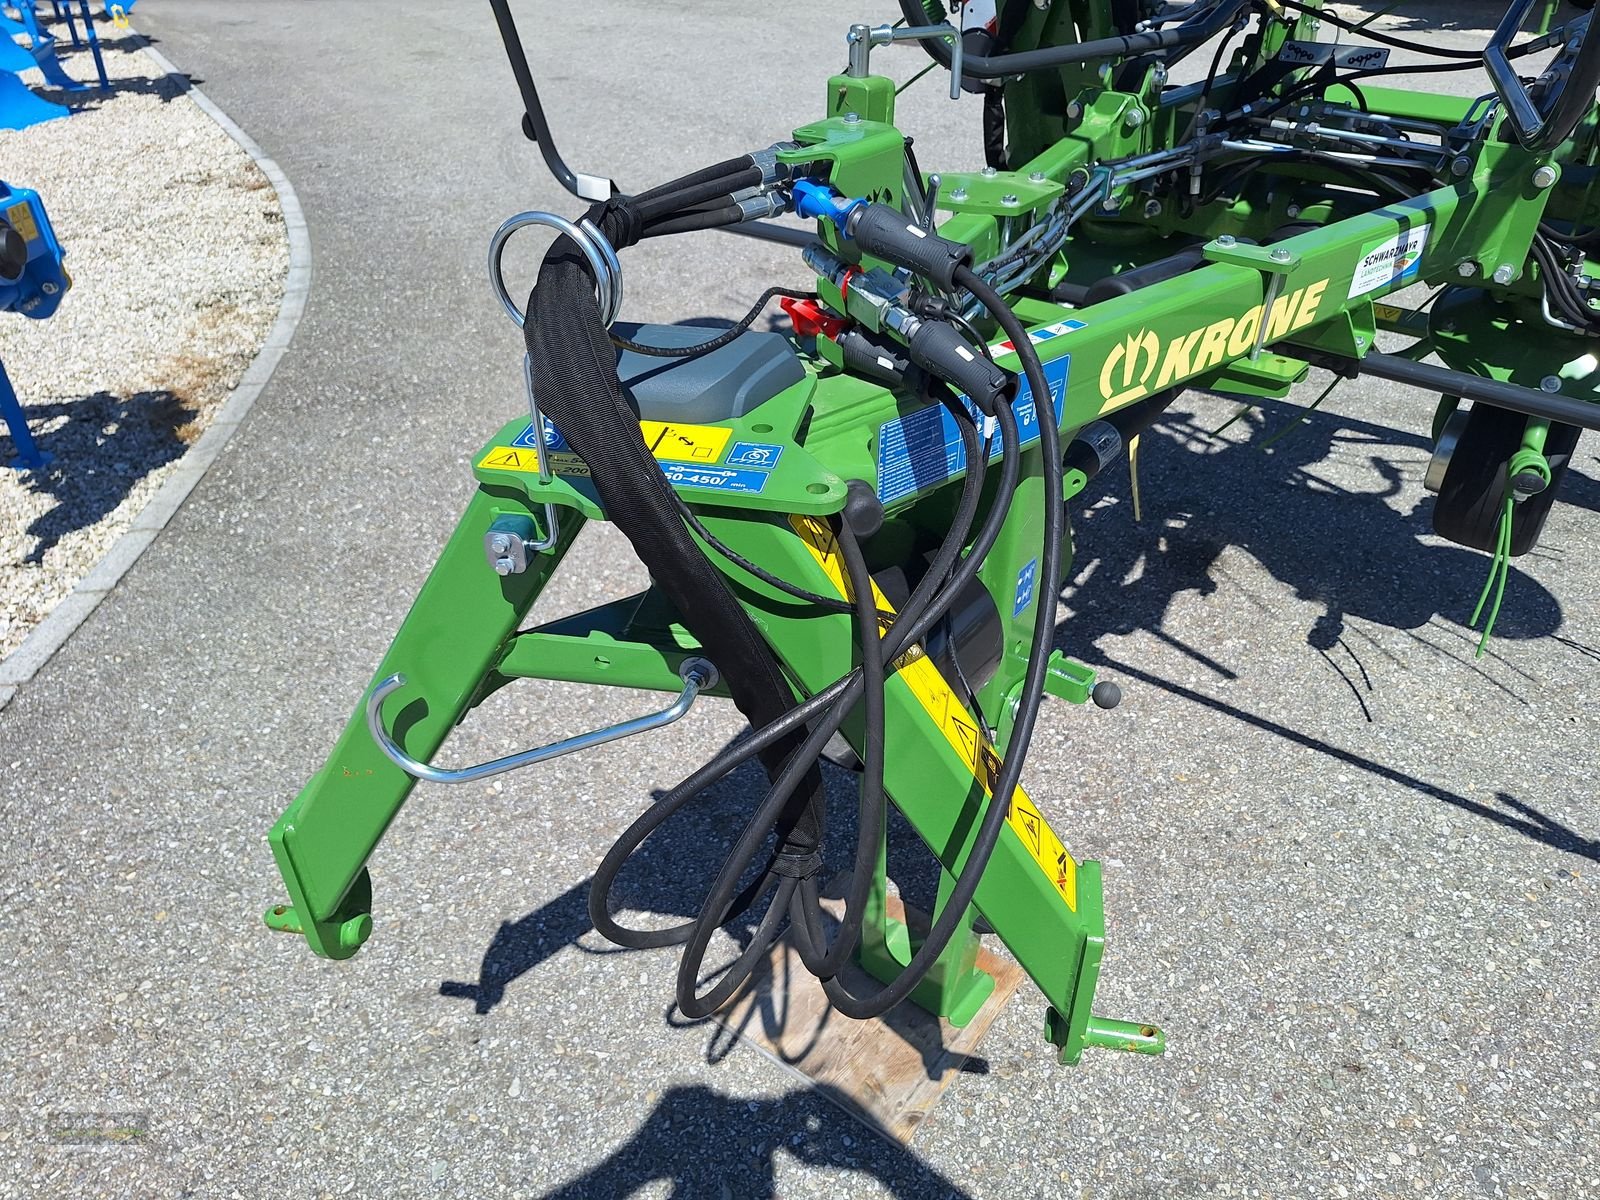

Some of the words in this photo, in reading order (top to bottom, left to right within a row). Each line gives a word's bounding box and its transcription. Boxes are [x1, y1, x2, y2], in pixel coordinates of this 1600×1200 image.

[1363, 240, 1418, 267] SCHWARZMAYR
[1154, 278, 1330, 390] KRONE
[562, 466, 589, 474] 200
